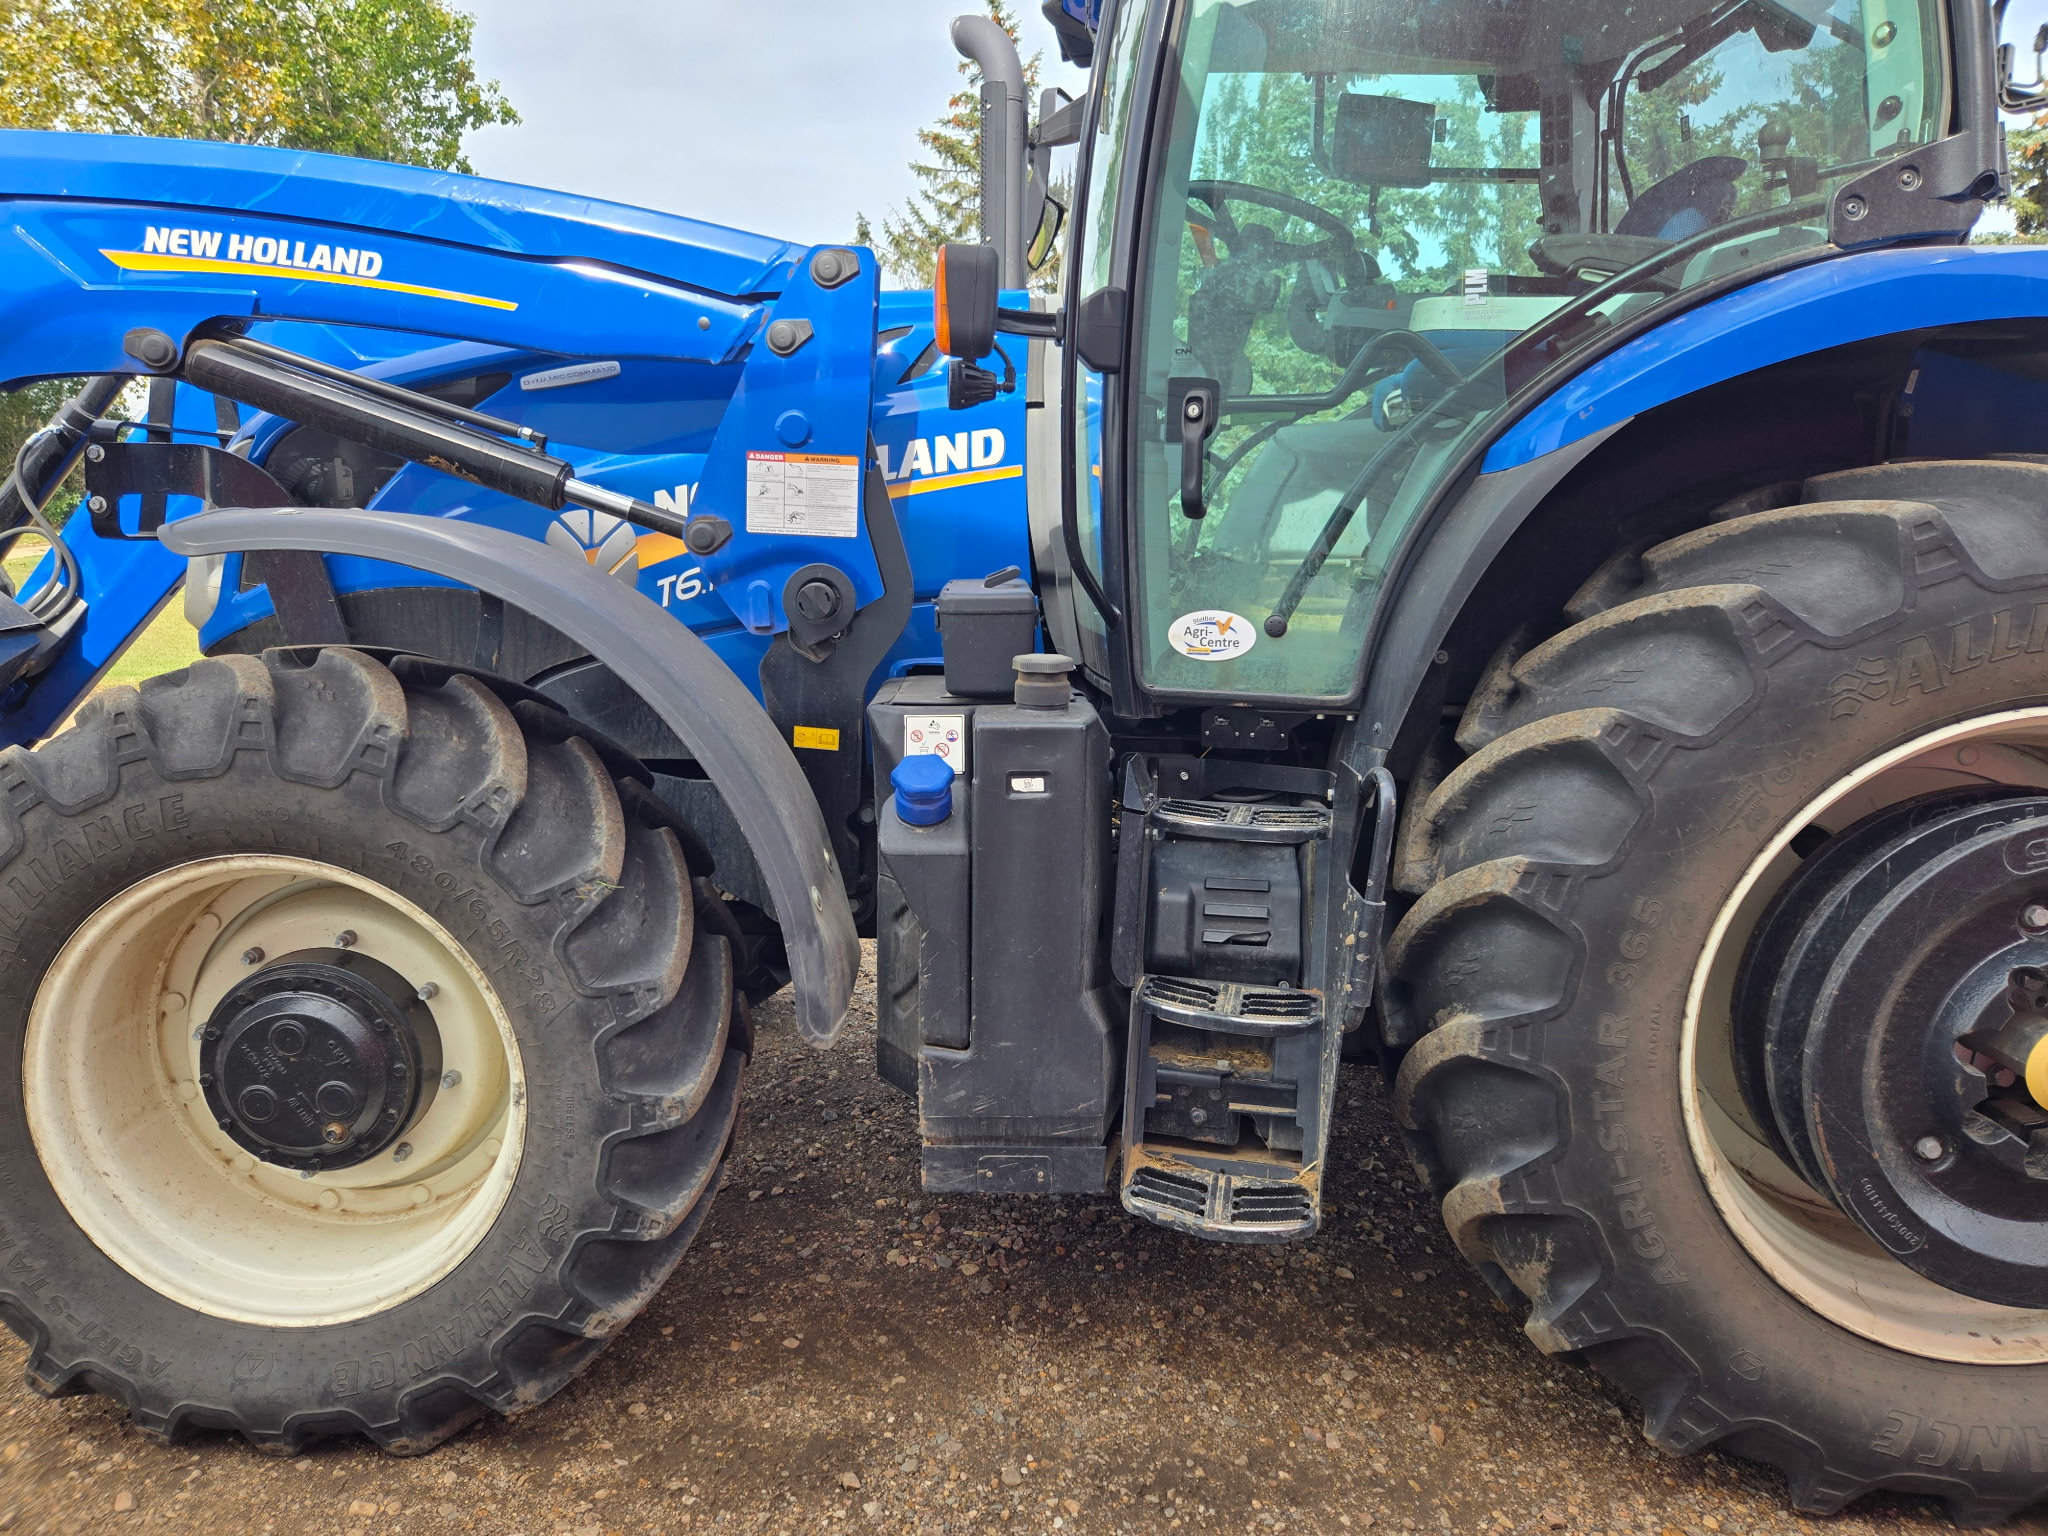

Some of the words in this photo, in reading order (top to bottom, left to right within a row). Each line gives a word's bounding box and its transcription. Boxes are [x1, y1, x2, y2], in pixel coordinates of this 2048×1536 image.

[143, 226, 222, 256] NEW
[228, 234, 383, 278] HOLLAND
[1465, 268, 1488, 306] PLM
[523, 373, 566, 386] DYNAMIC
[567, 365, 617, 378] COMMAND
[755, 453, 784, 461] DANGER
[1184, 626, 1213, 638] Agri-
[1193, 616, 1216, 625] Stettler
[1200, 637, 1240, 647] Centre
[386, 841, 556, 1014] 480/65R28
[1606, 896, 1665, 992] 365
[565, 1090, 576, 1141] TUBELESS
[1593, 1012, 1692, 1286] AGRI-STAR
[334, 1226, 552, 1399] ALLIANCE
